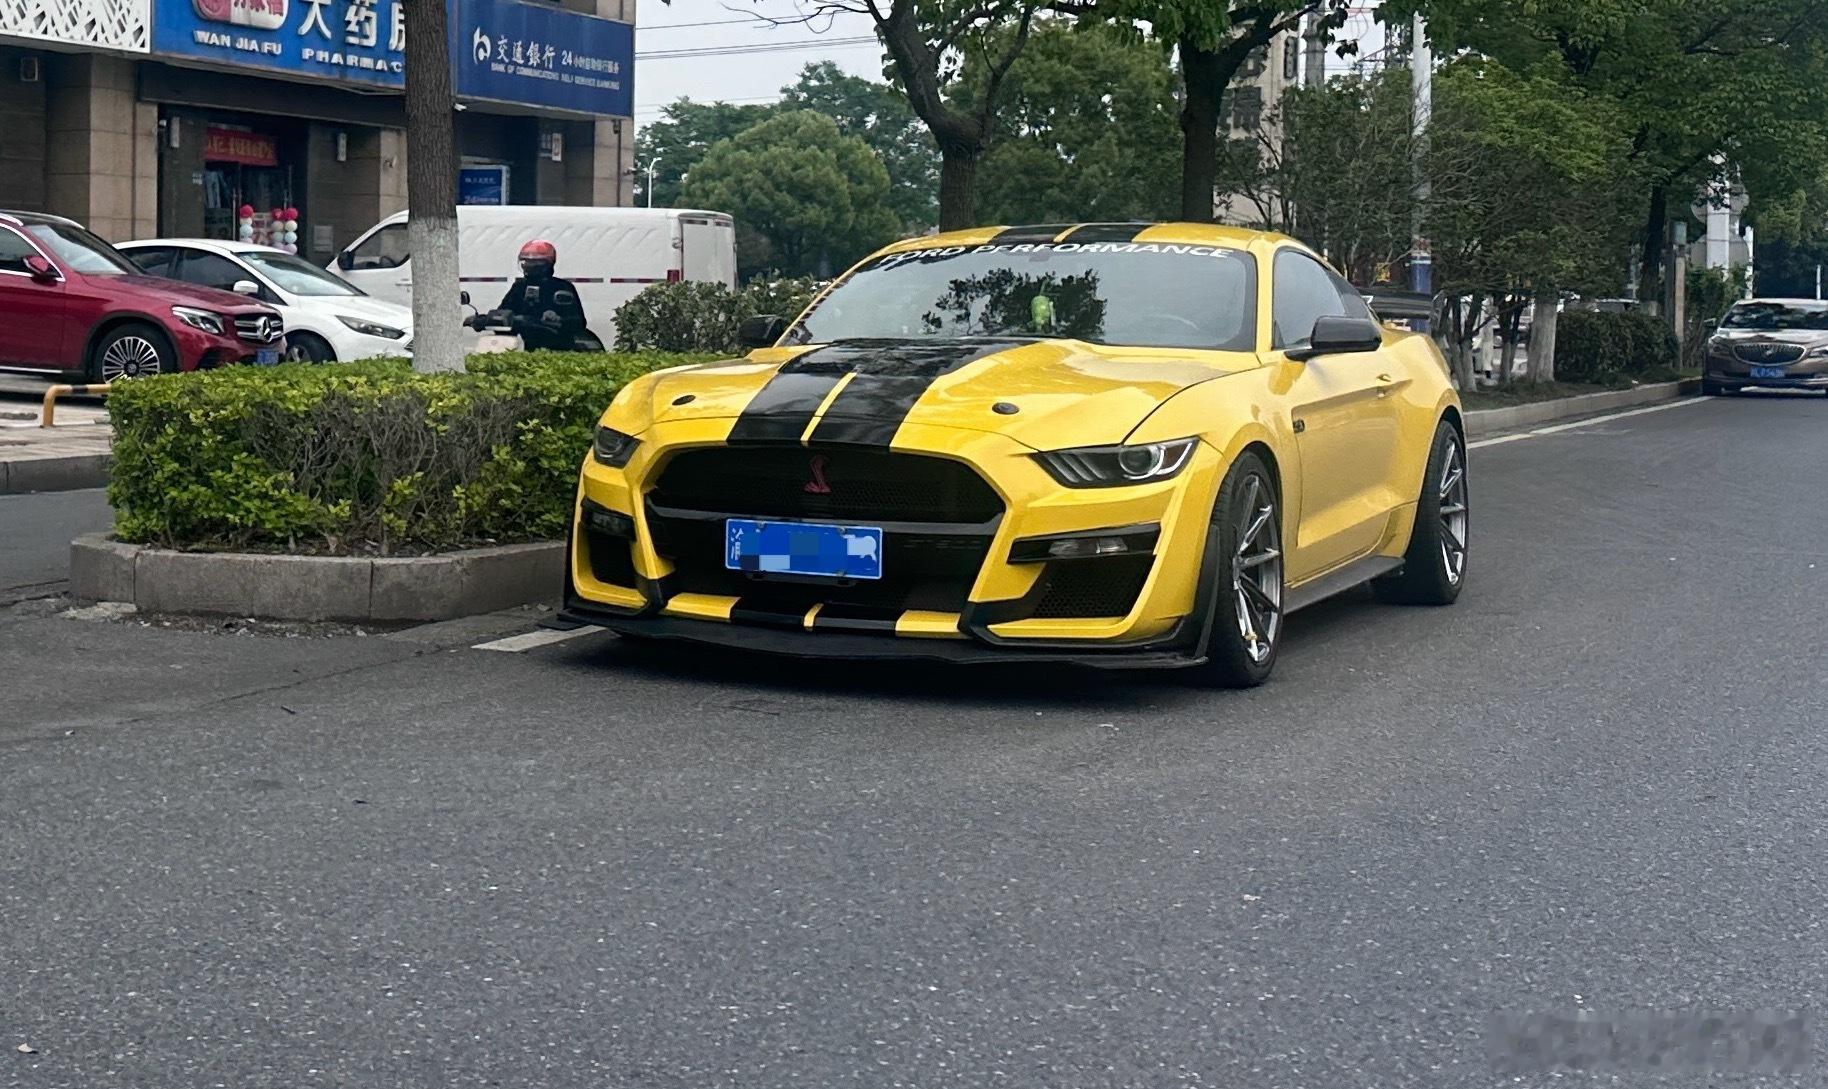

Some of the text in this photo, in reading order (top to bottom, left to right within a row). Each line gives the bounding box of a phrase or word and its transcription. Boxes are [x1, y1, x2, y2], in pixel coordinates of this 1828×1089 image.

[193, 30, 282, 55] WAN JIA FU
[302, 48, 403, 73] PHARMAC
[879, 243, 1235, 265] FORD PERFORMANCE
